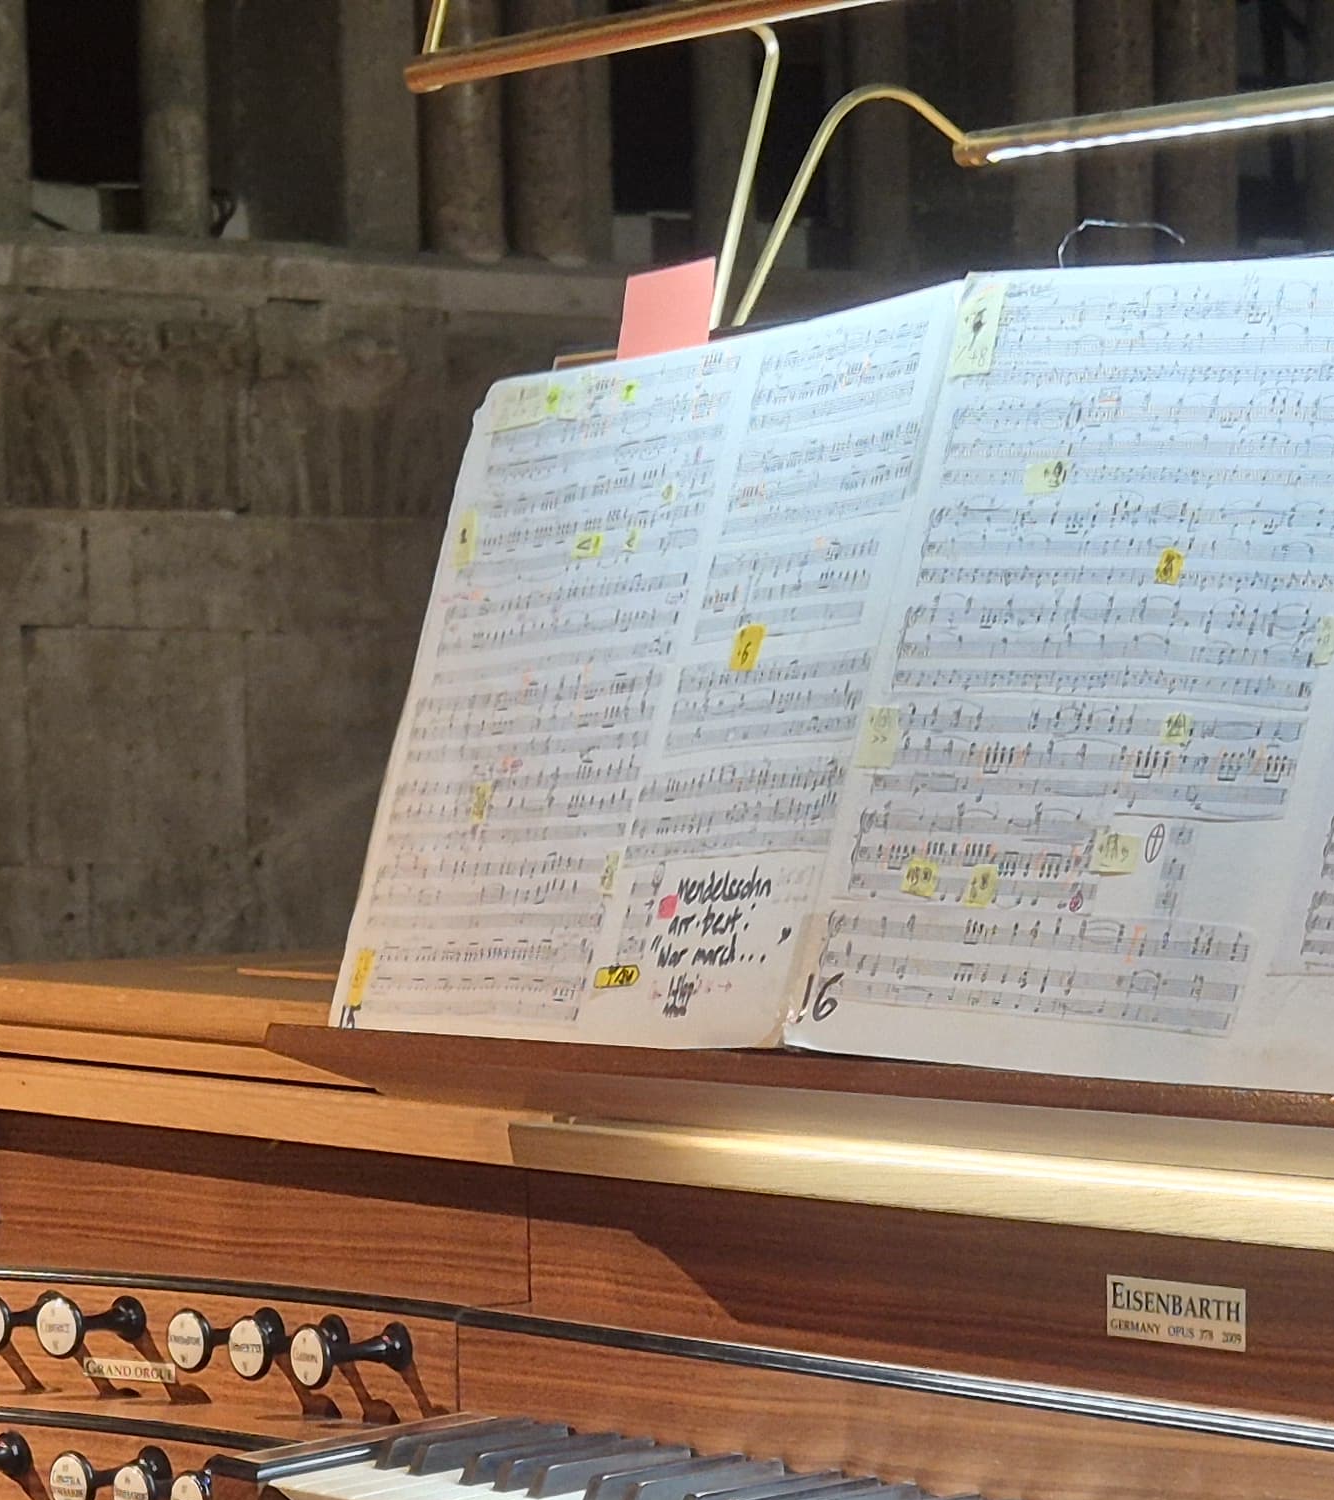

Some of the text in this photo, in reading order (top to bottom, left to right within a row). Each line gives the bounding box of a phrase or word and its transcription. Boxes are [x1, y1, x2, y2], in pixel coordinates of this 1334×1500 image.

[795, 973, 845, 1024] 16
[1111, 1281, 1241, 1322] EISENBARTH
[1110, 1319, 1161, 1336] GERMANY
[1167, 1326, 1196, 1341] OPUS
[85, 1359, 132, 1378] GRAND
